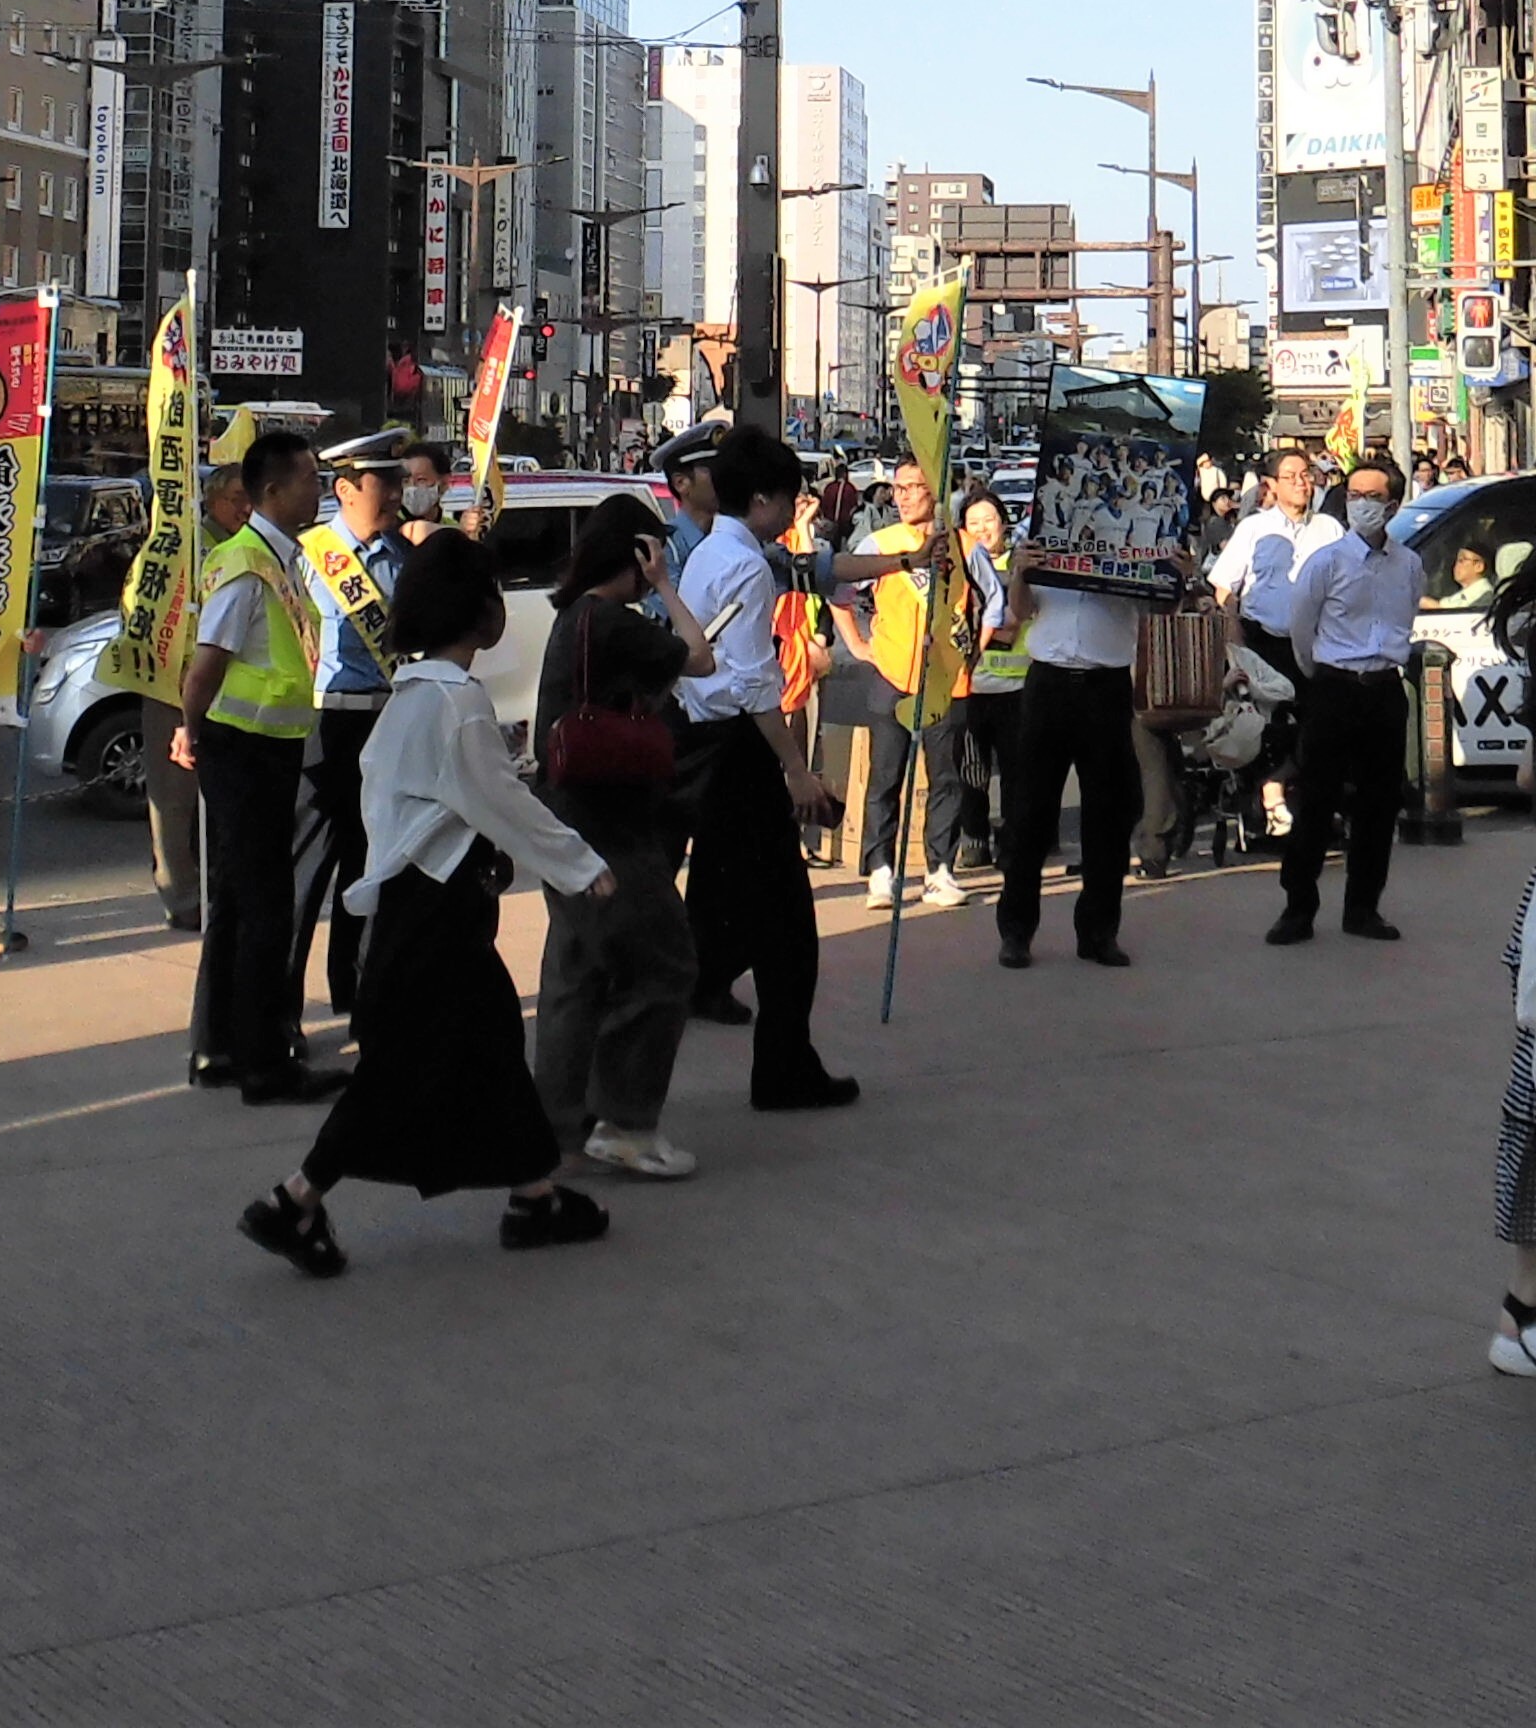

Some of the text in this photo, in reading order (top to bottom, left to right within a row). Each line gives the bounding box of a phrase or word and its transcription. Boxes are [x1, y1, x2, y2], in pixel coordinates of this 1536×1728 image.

[94, 105, 109, 195] toyoko inn
[214, 354, 297, 373] おみやげ処
